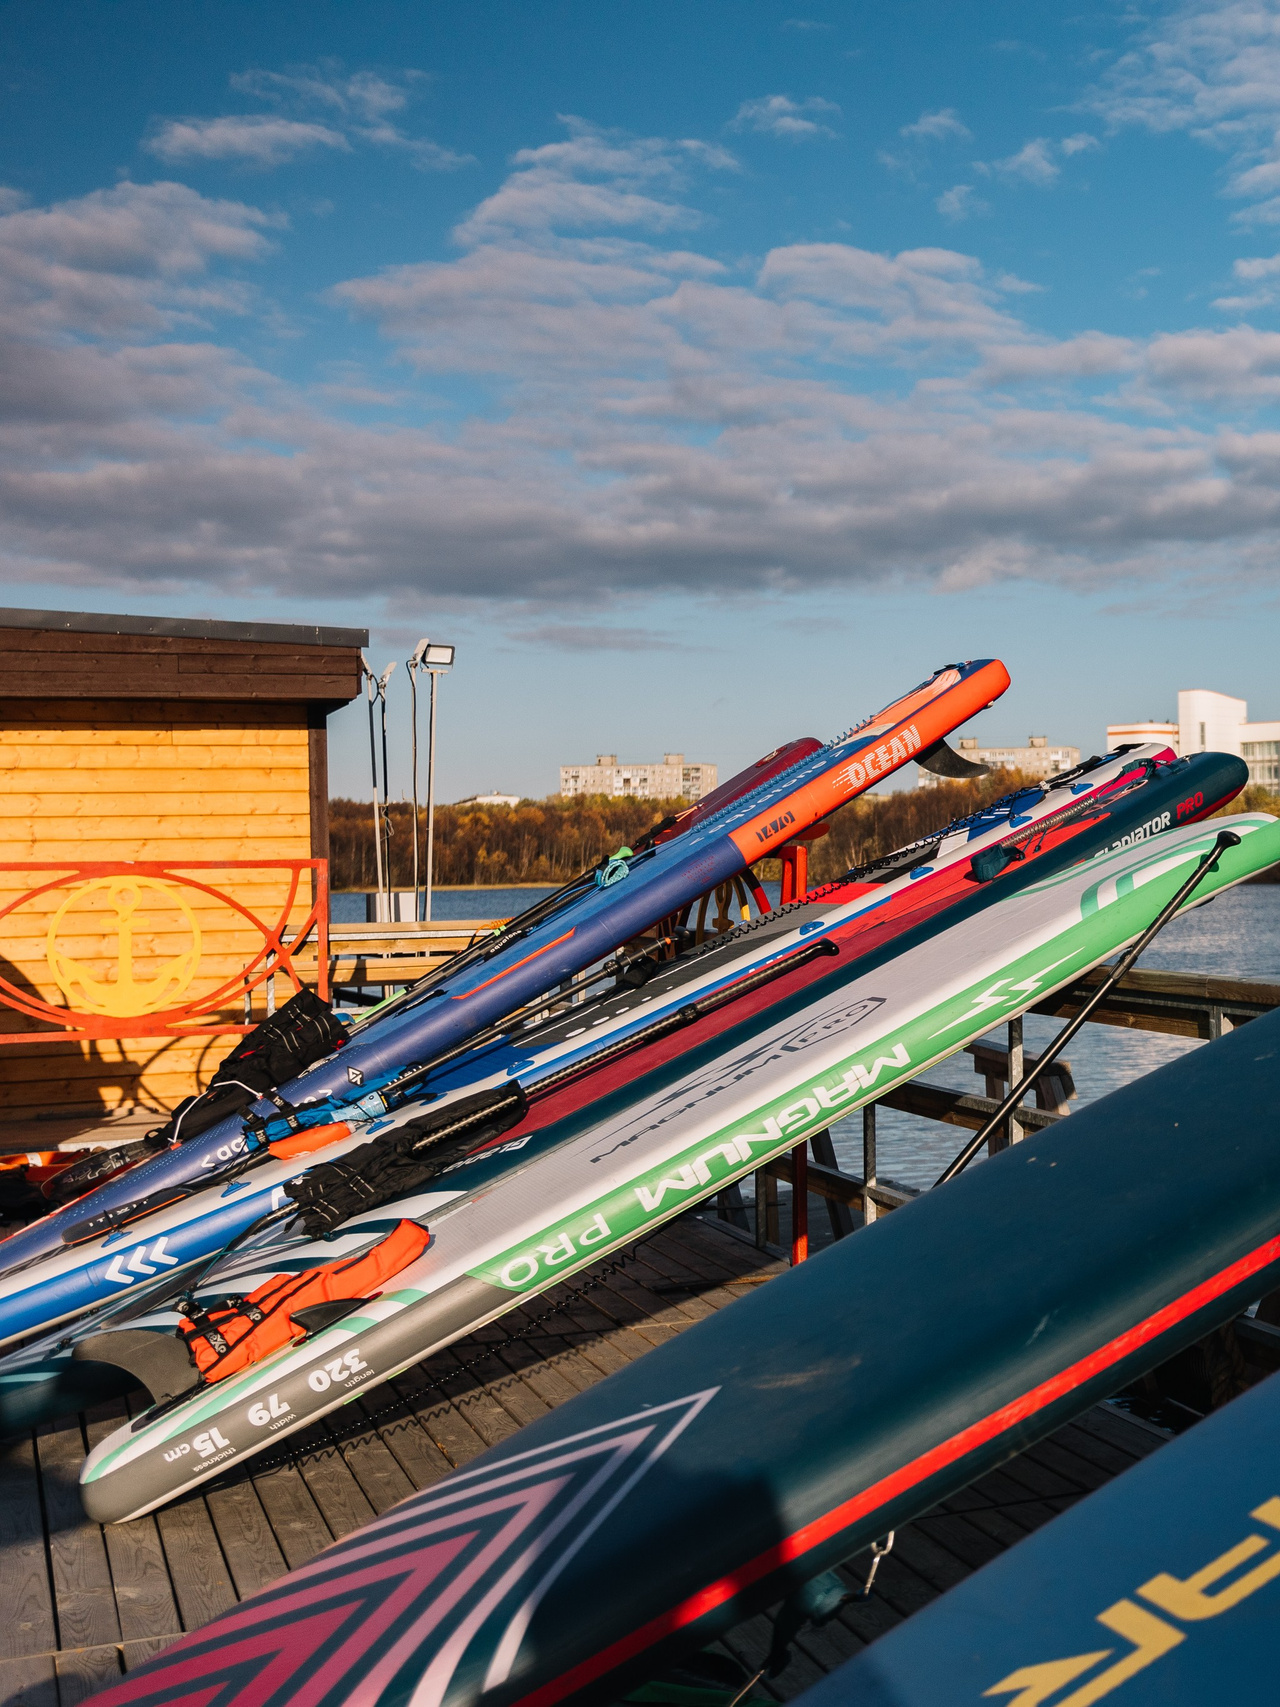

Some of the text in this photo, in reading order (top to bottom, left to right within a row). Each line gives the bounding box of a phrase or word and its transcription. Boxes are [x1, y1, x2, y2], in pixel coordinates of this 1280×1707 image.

[848, 724, 922, 789] OCEAN
[708, 759, 828, 834] aquatone
[1094, 791, 1204, 858] ADIATOR PRO
[590, 1003, 869, 1163] MAGNUM PRO
[500, 1042, 912, 1289] MAGNUM PRO
[308, 1348, 368, 1393] 320
[344, 1369, 376, 1389] length
[247, 1393, 291, 1427] 79
[269, 1413, 297, 1431] width
[163, 1426, 231, 1463] 15 cm
[193, 1447, 237, 1473] thickness
